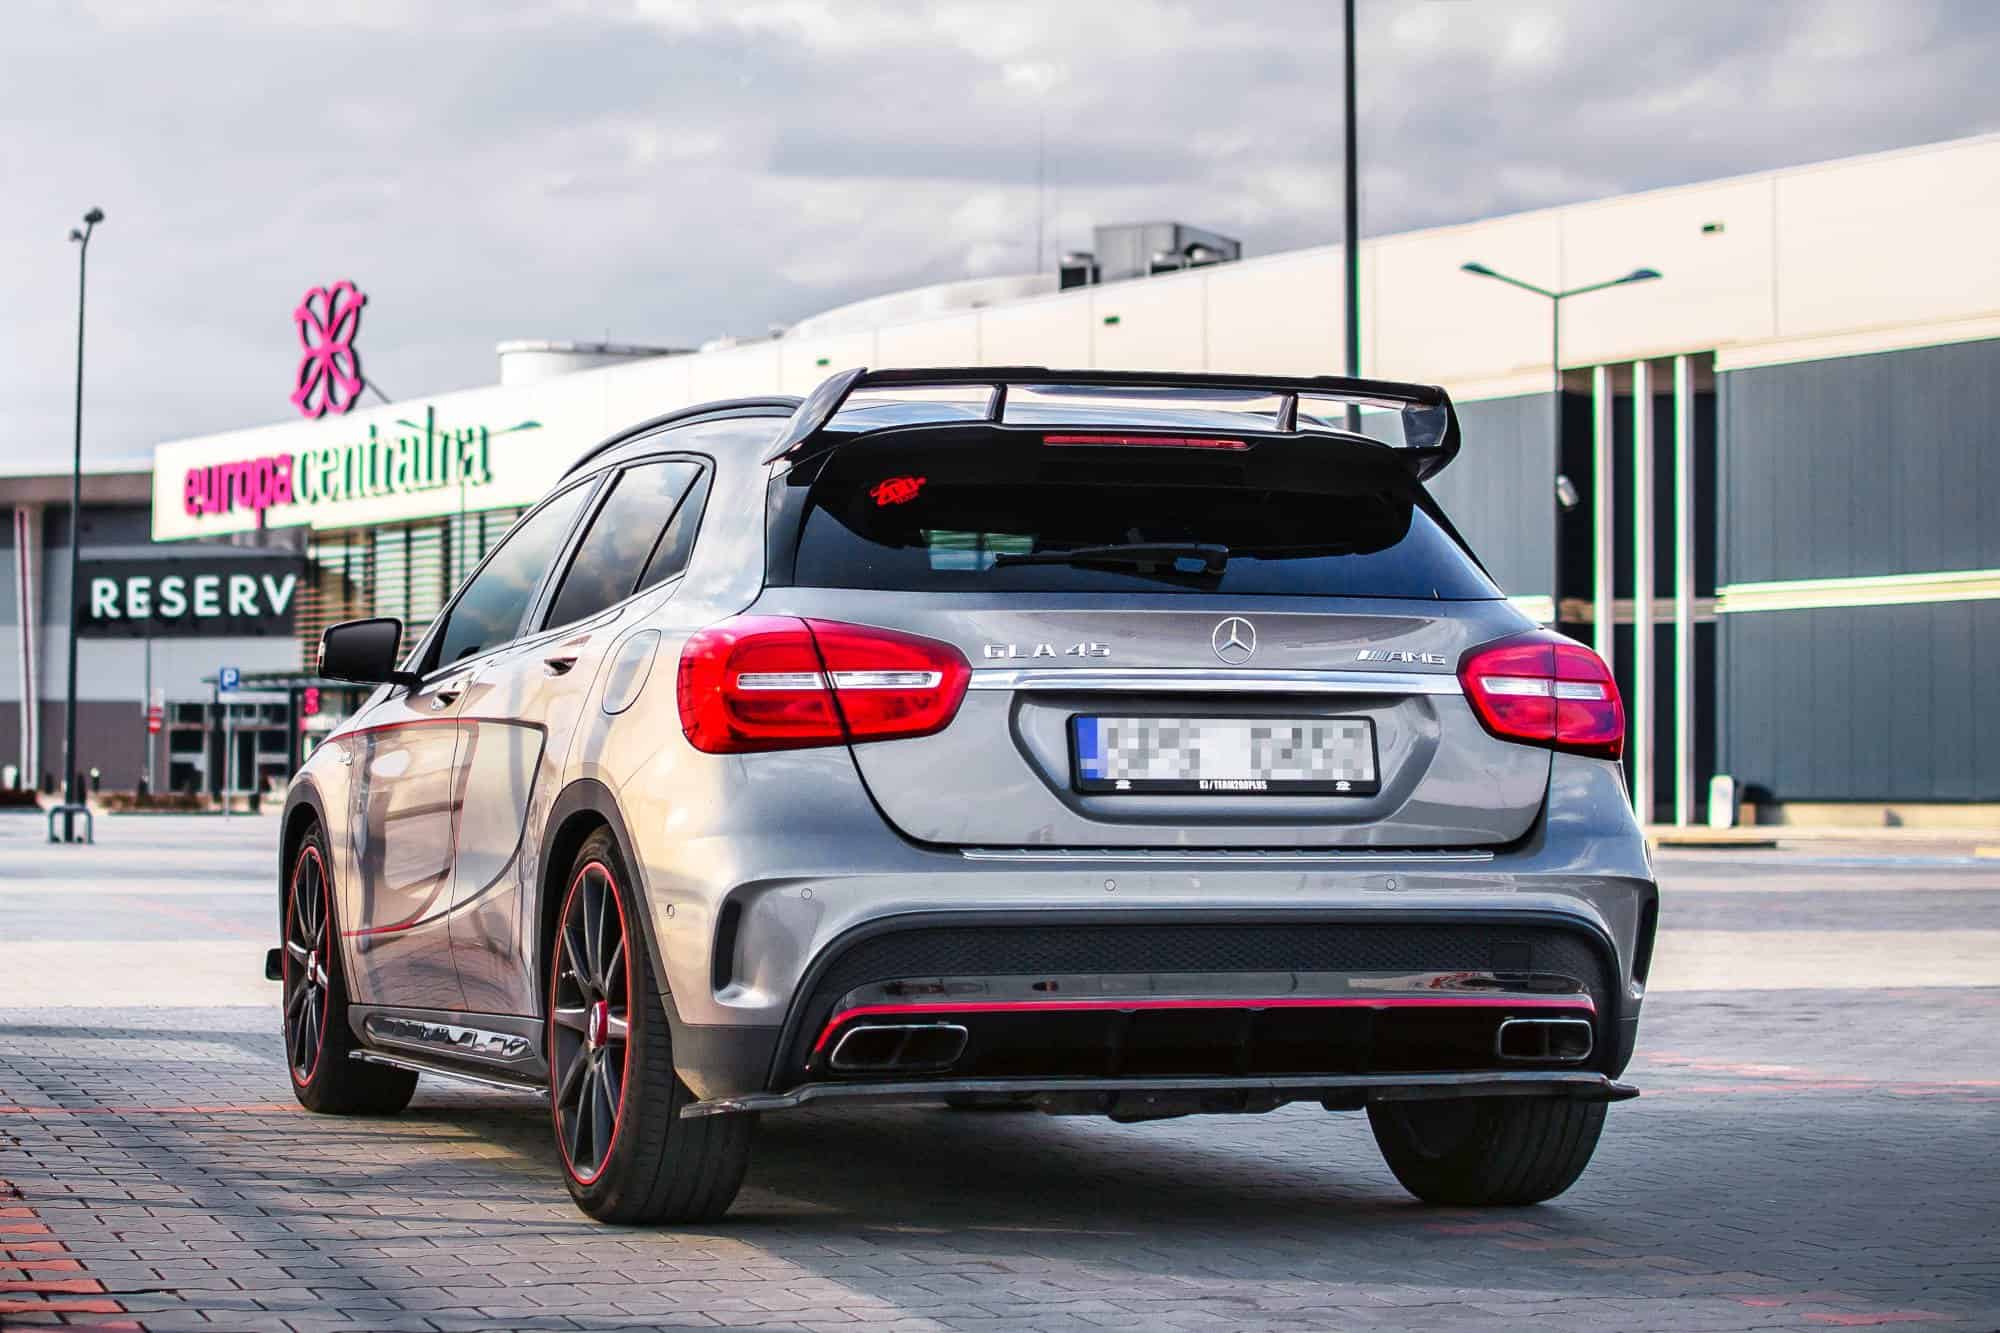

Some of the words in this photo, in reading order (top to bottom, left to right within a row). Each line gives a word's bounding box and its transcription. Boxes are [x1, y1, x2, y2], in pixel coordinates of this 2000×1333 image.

[91, 574, 296, 618] RESERV
[983, 642, 1057, 659] GLA
[1064, 641, 1112, 658] 45
